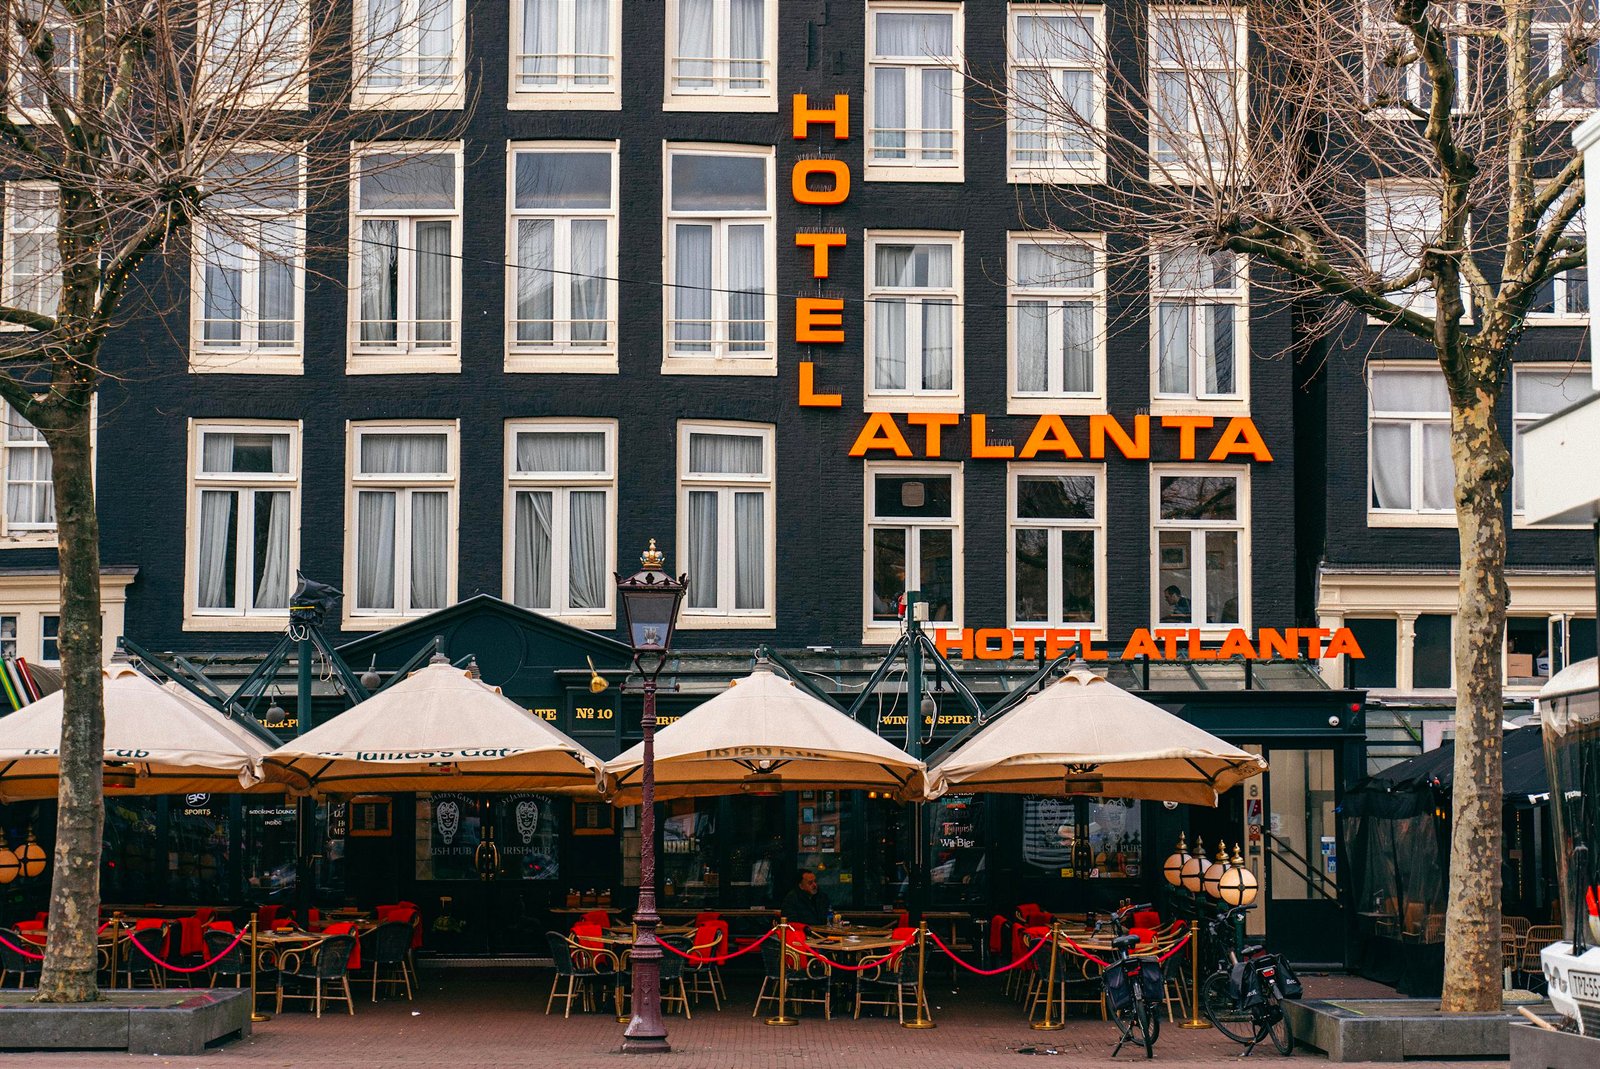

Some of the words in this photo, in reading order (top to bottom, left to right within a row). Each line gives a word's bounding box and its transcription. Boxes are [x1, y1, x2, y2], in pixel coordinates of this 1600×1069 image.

[791, 93, 850, 407] HOTEL
[849, 412, 1273, 462] ATLANTA
[934, 627, 1108, 661] HOTEL
[1121, 627, 1365, 660] ATLANTA
[597, 708, 613, 719] 10
[881, 715, 909, 725] WIN
[1249, 784, 1258, 797] 8
[184, 808, 211, 816] SPORTS
[452, 846, 472, 855] PUB
[503, 846, 528, 855] IRISH
